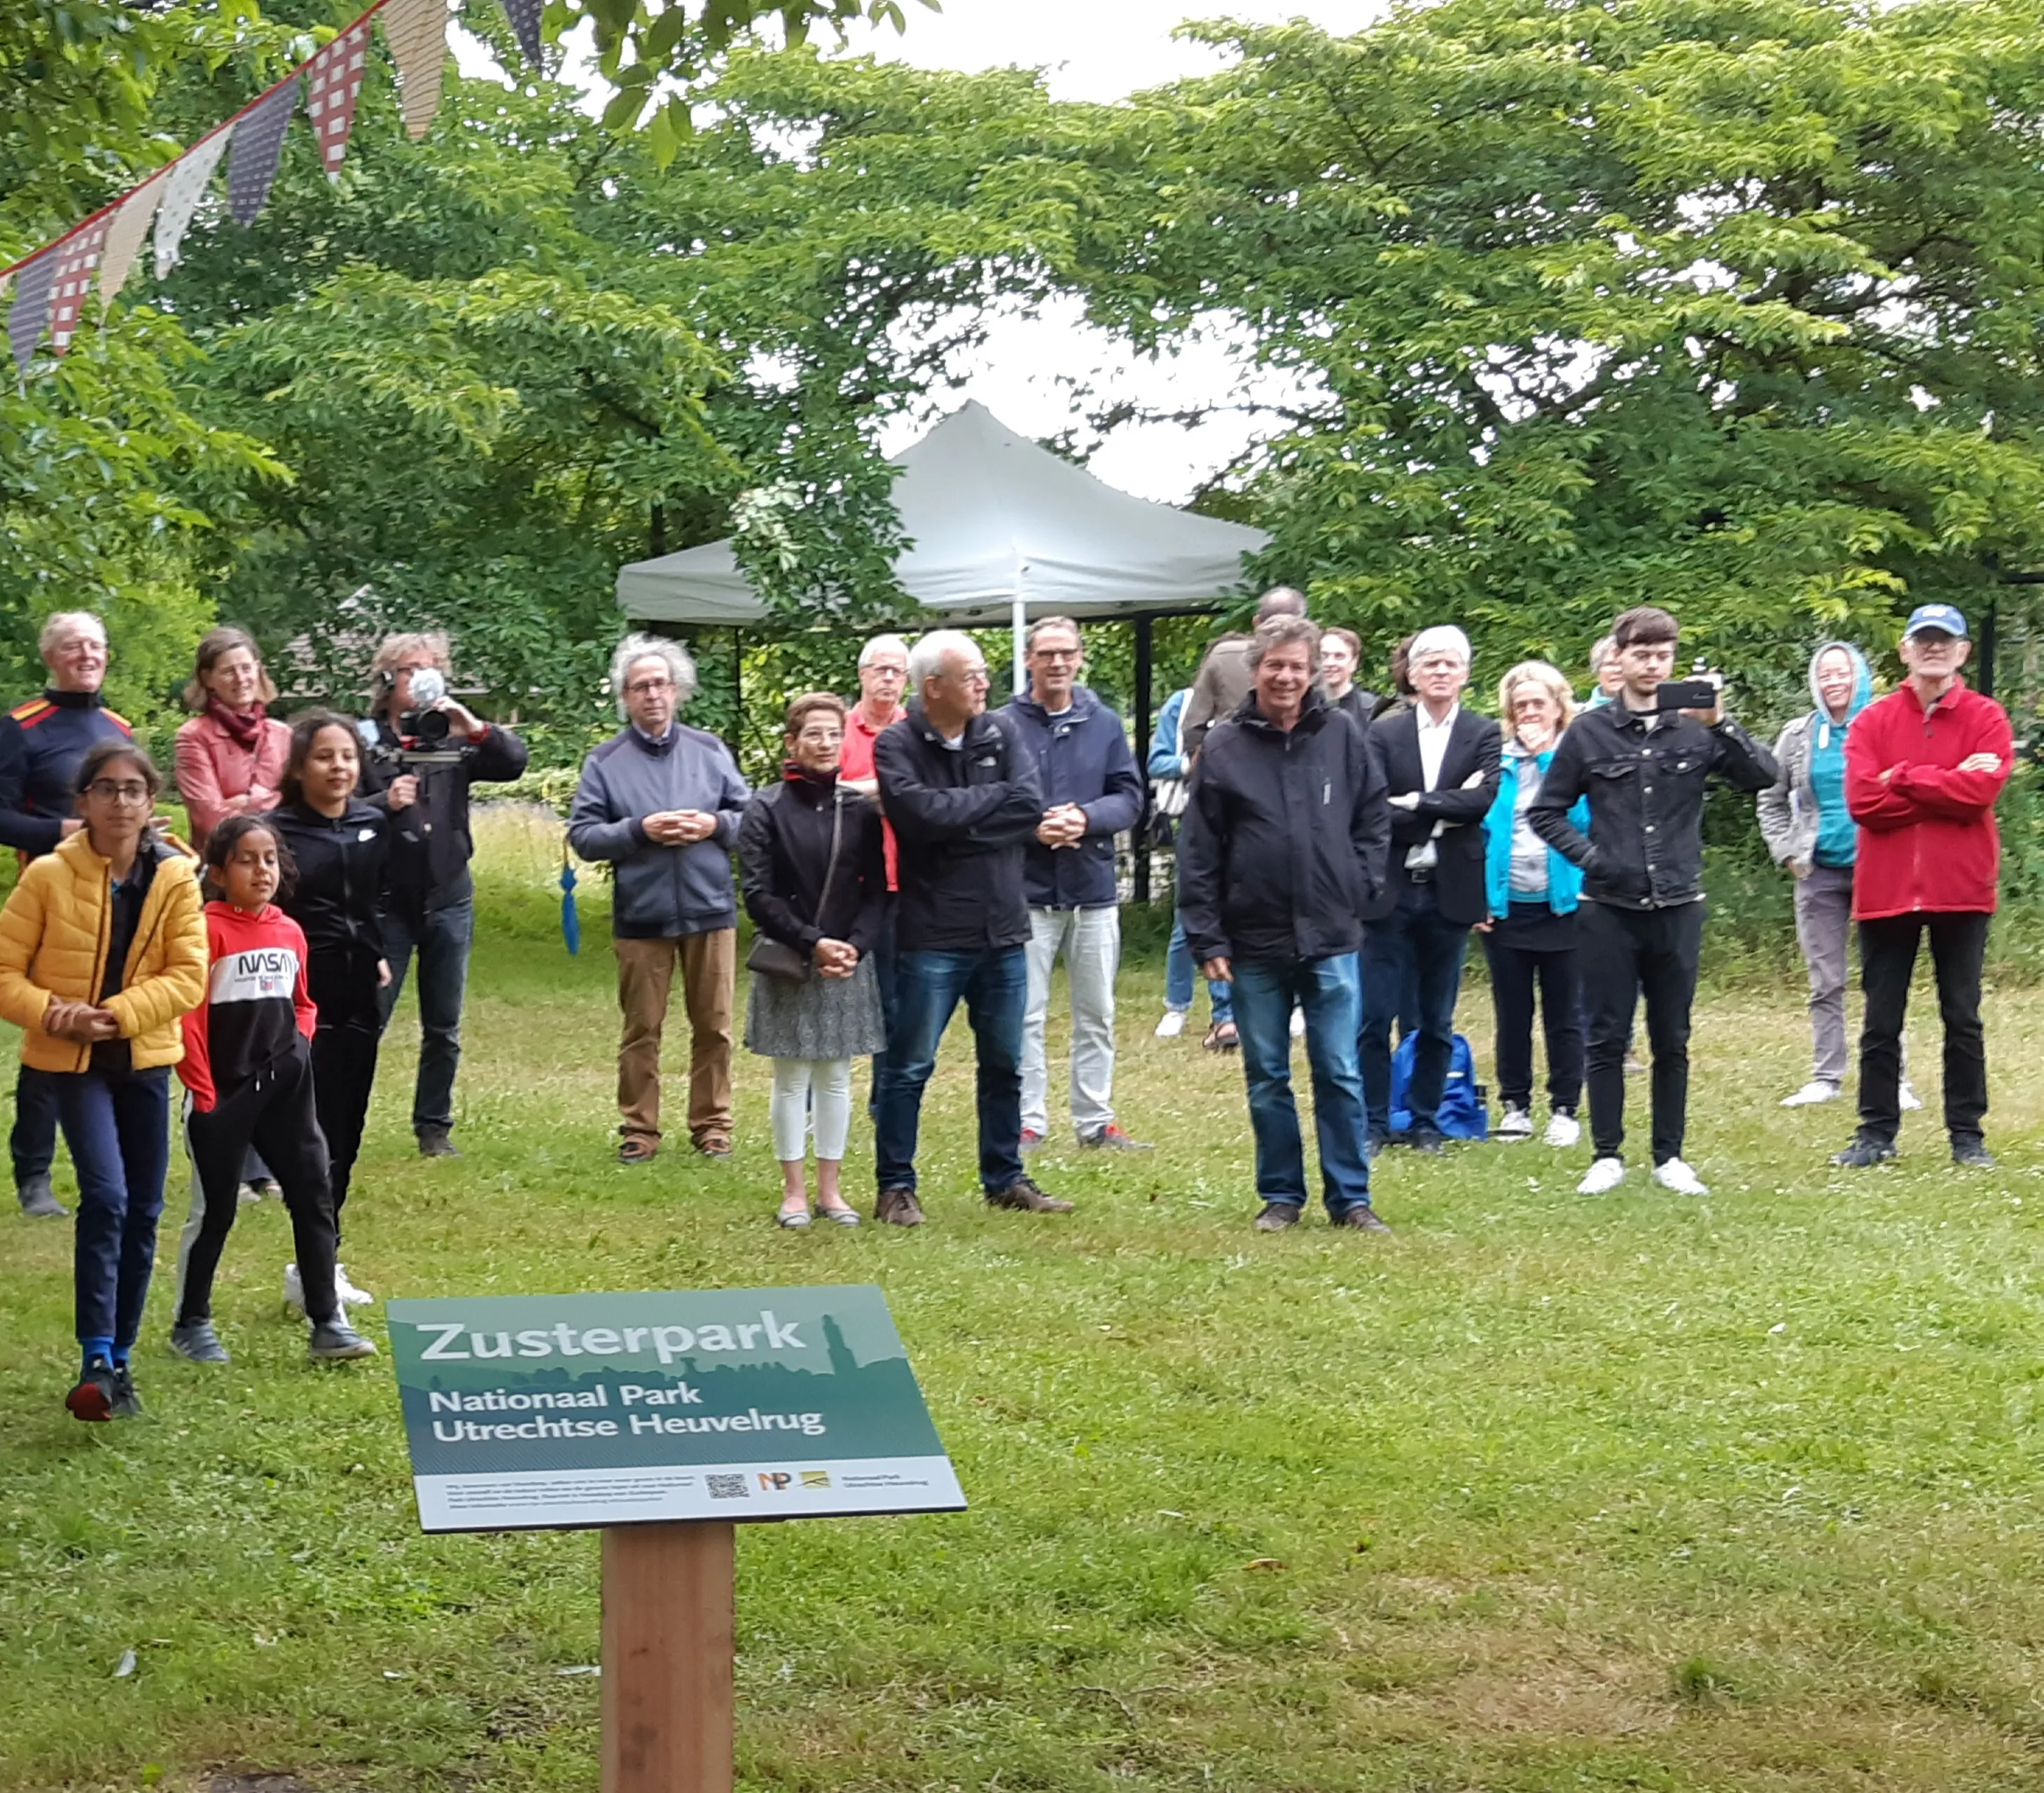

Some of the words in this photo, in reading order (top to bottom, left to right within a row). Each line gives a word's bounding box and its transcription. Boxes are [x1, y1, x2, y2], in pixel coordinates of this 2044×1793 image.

[239, 953, 288, 975] NASA
[416, 1310, 807, 1364] Zusterpark
[429, 1384, 609, 1412] Nationaal
[619, 1381, 704, 1406] Park
[432, 1415, 618, 1442] Utrechtse
[628, 1408, 826, 1435] Heuvelrug
[756, 1472, 791, 1490] NP
